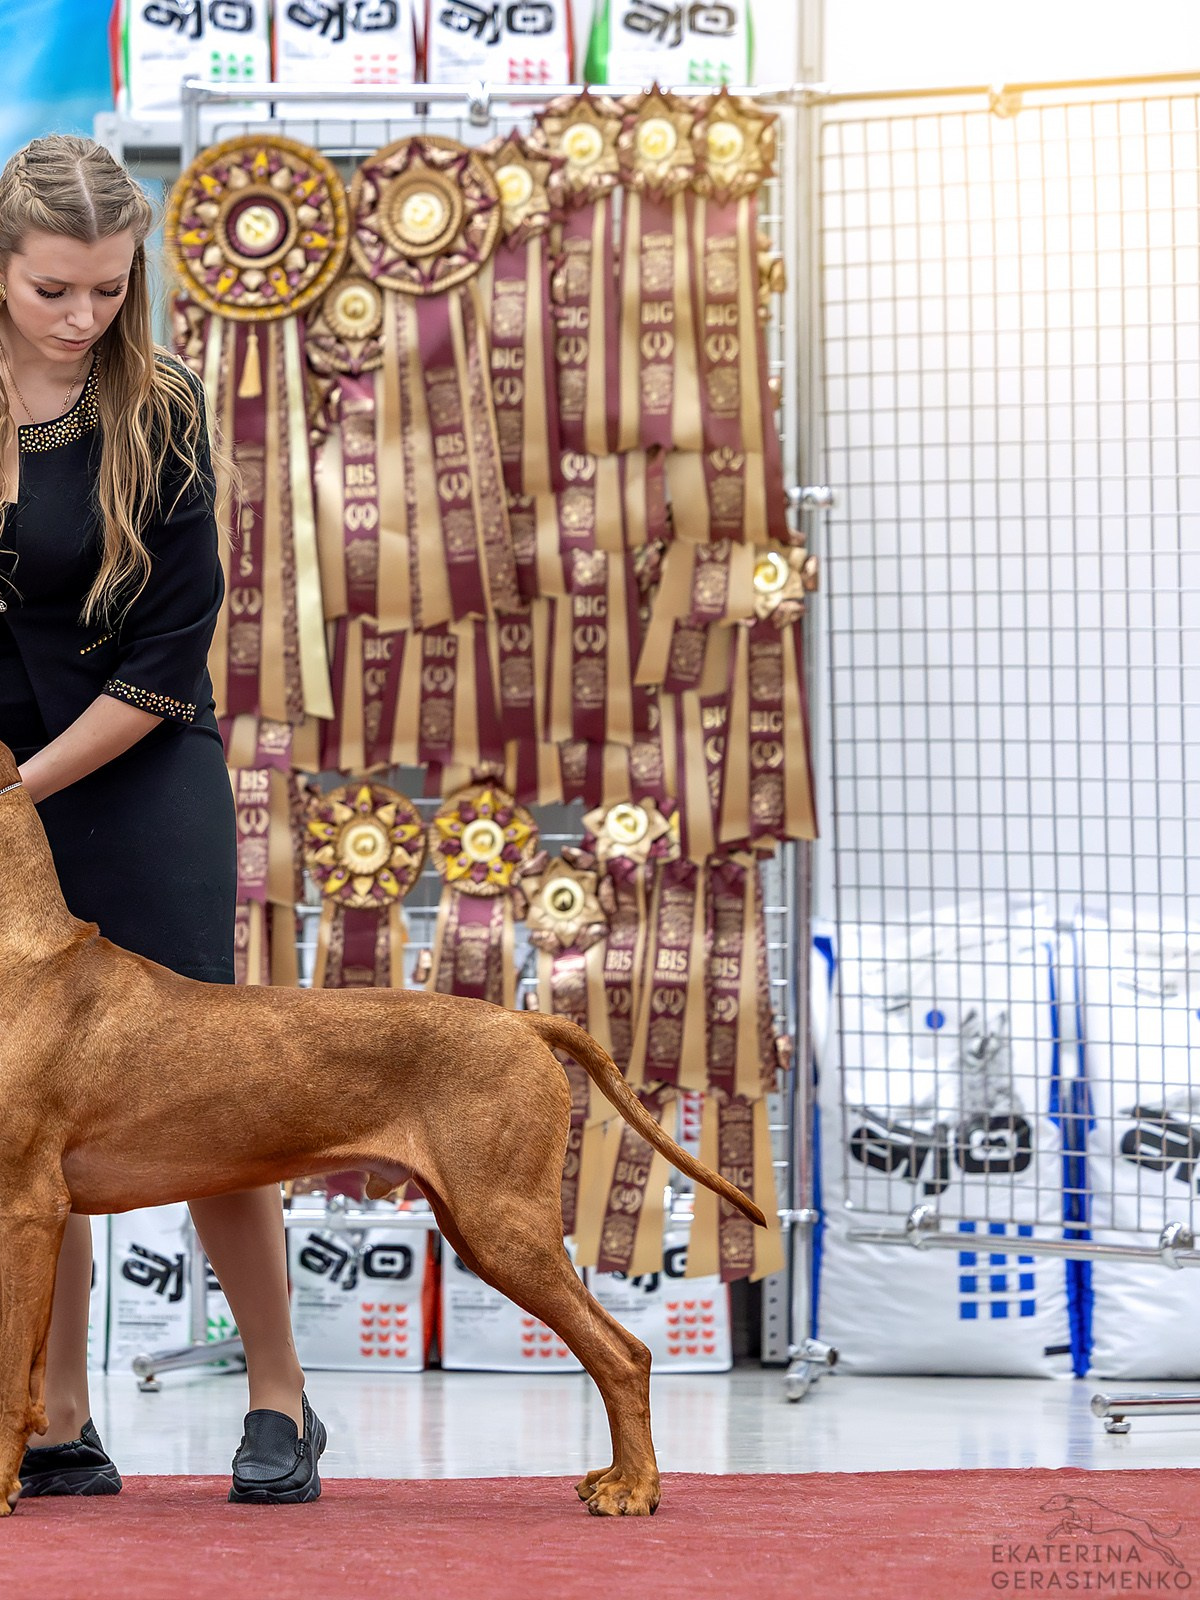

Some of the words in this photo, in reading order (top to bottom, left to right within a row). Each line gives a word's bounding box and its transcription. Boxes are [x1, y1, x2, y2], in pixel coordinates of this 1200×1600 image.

[345, 464, 376, 485] BIS
[574, 594, 607, 618] BIG
[239, 769, 269, 790] BIS
[605, 949, 633, 971] BIS
[657, 949, 688, 971] BIS
[615, 1161, 649, 1186] BIG
